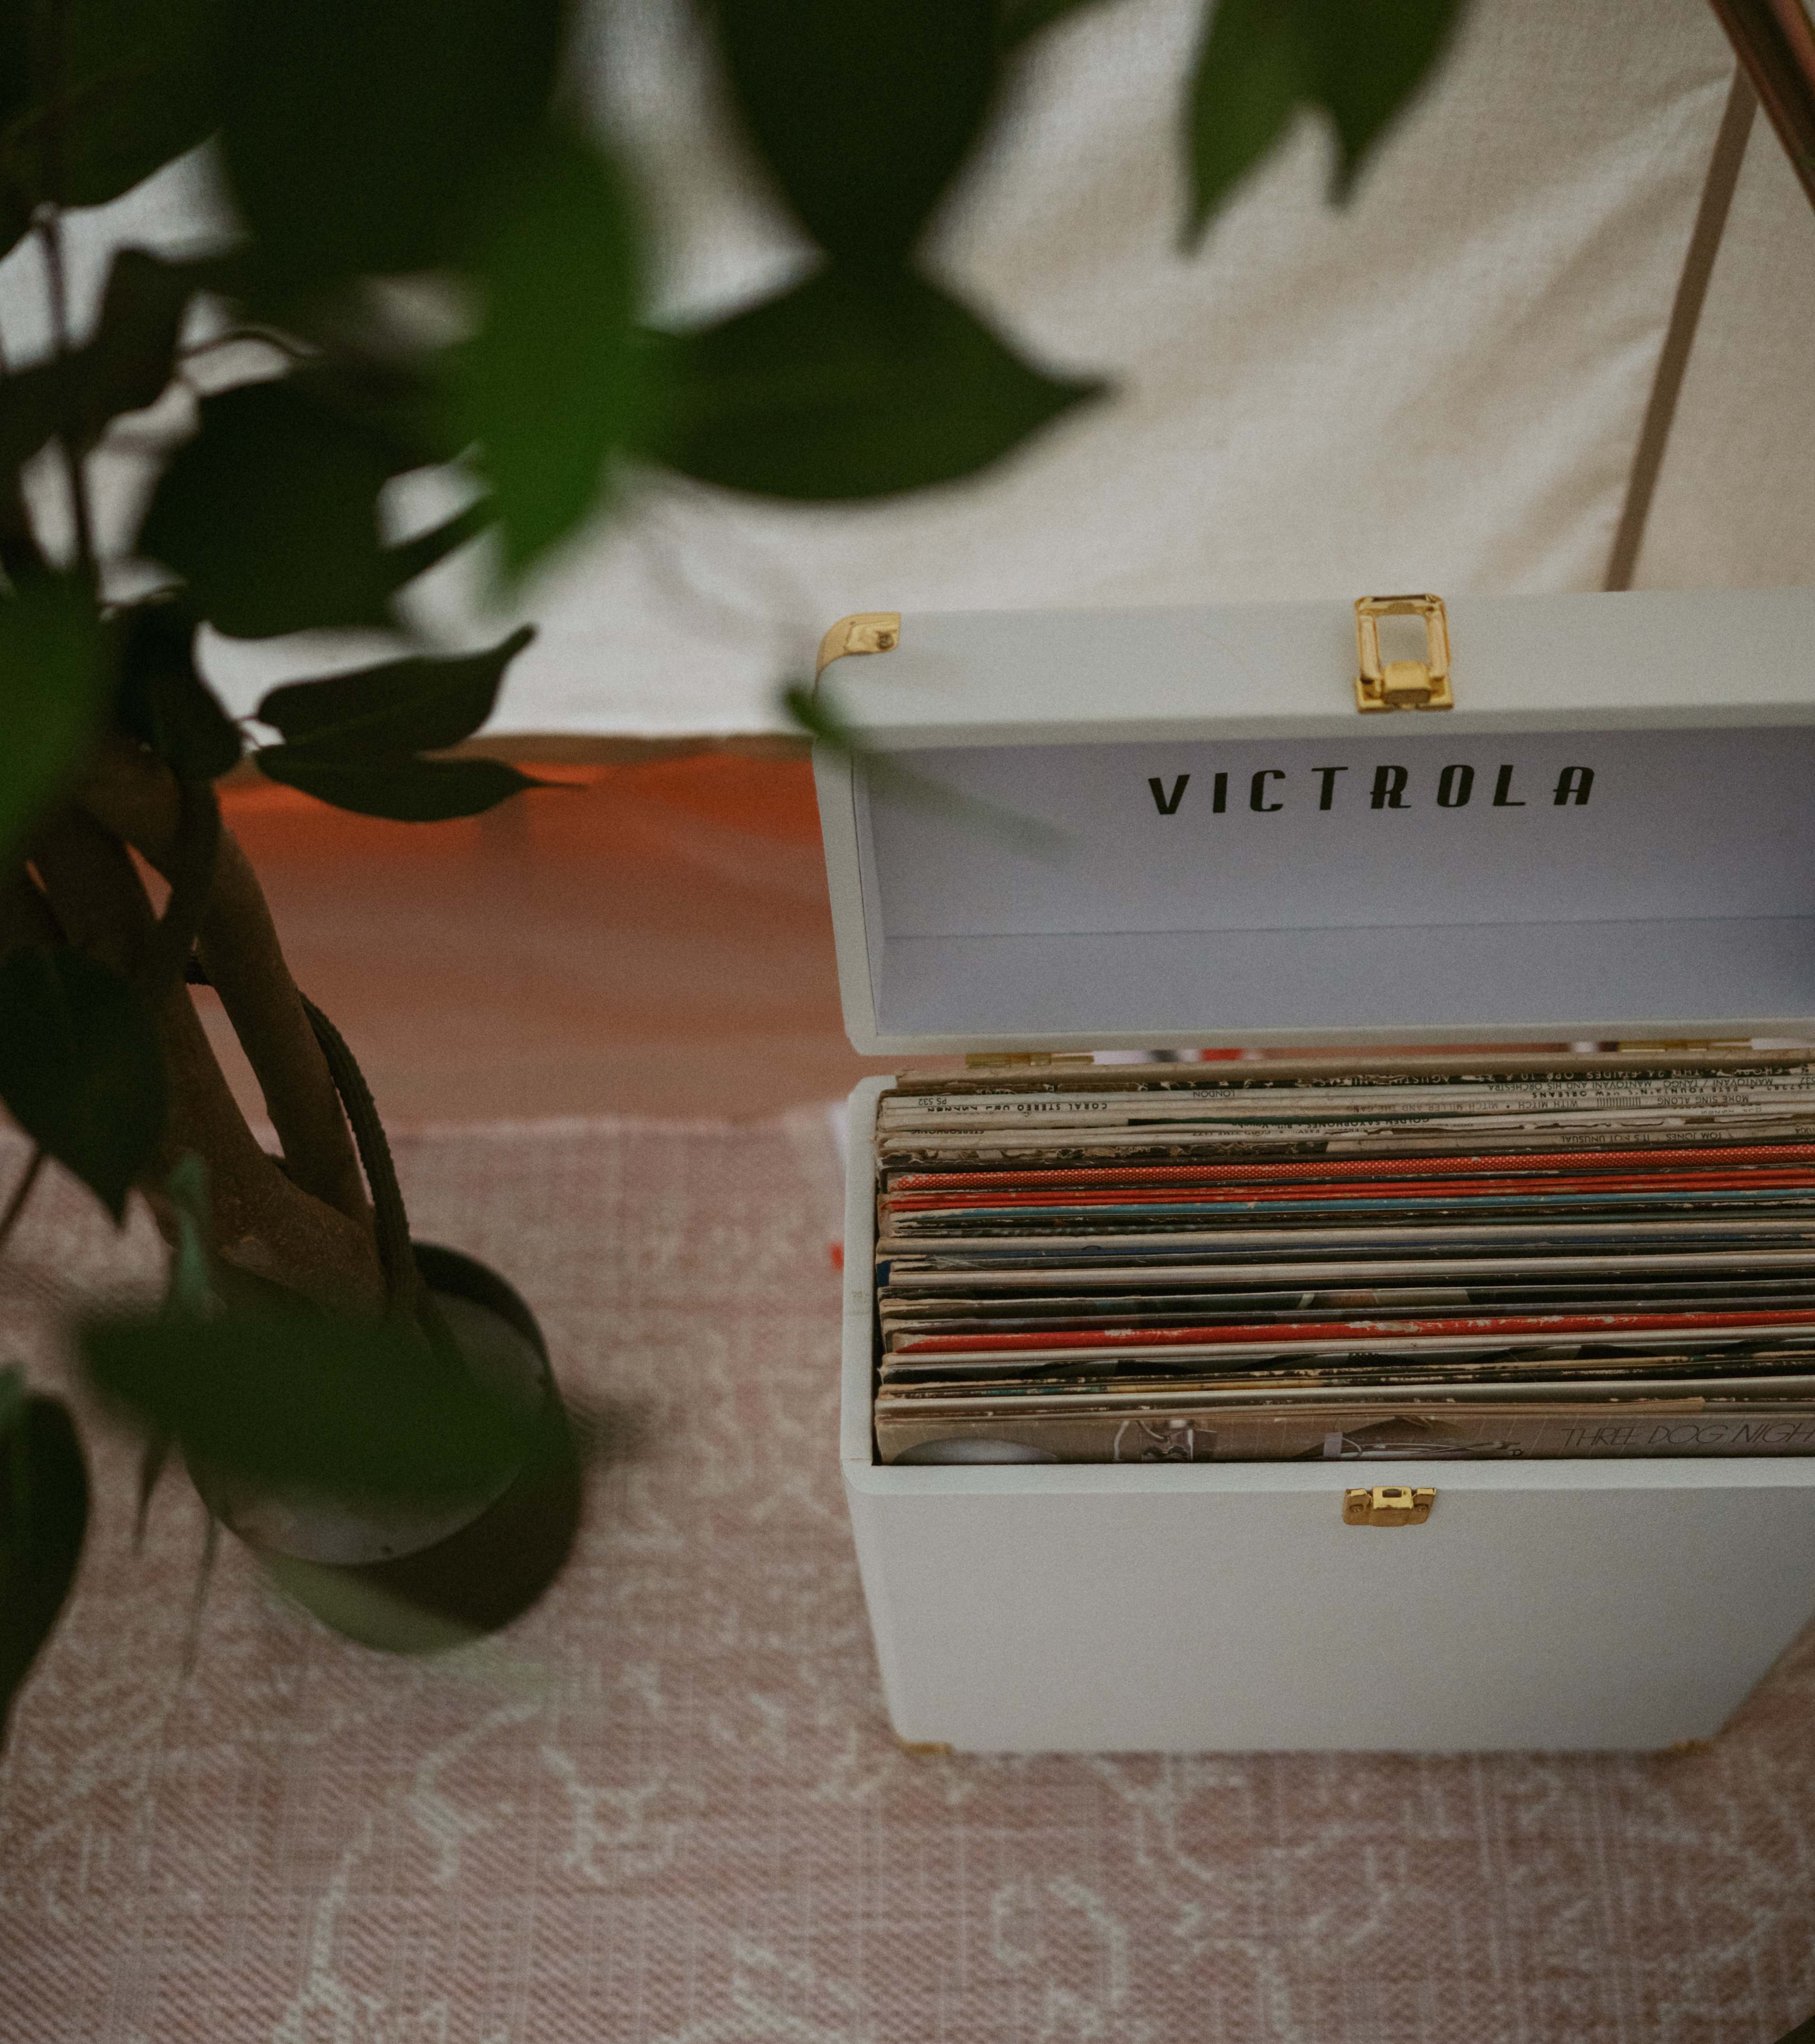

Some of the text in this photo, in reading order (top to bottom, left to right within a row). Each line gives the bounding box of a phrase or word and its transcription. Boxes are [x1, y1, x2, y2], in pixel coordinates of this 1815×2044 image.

[1148, 764, 1595, 815] VICTROLA
[1547, 1082, 1561, 1091] HIS
[1567, 1082, 1587, 1090] AND
[1592, 1080, 1651, 1089] MANTOVANI
[1663, 1079, 1697, 1088] TANGO
[1713, 1078, 1773, 1087] MANTOVANI
[1487, 1083, 1542, 1092] ORCHESTRA
[1192, 1090, 1235, 1098] LONDON
[1531, 1090, 1586, 1099] ORLEANS
[1724, 1094, 1749, 1103] MORE
[1657, 1097, 1690, 1106] ALONG
[1695, 1095, 1717, 1104] SING
[1017, 1103, 1060, 1111] STEREO
[1068, 1102, 1107, 1110] CORAL
[1402, 1104, 1422, 1112] AND
[1428, 1102, 1462, 1111] MILLER
[1469, 1101, 1498, 1110] MITCH
[1518, 1100, 1548, 1109] MITCH
[1554, 1100, 1578, 1109] WITH
[1306, 1120, 1380, 1129] SAXOPHONES
[1795, 1126, 1815, 1135] 004
[1560, 1135, 1605, 1143] UNUSUAL
[1634, 1134, 1650, 1142] IT'S
[1665, 1132, 1696, 1142] JONES
[1701, 1132, 1721, 1140] TOM
[1560, 1426, 1643, 1446] THREE
[1648, 1424, 1728, 1445] DOG
